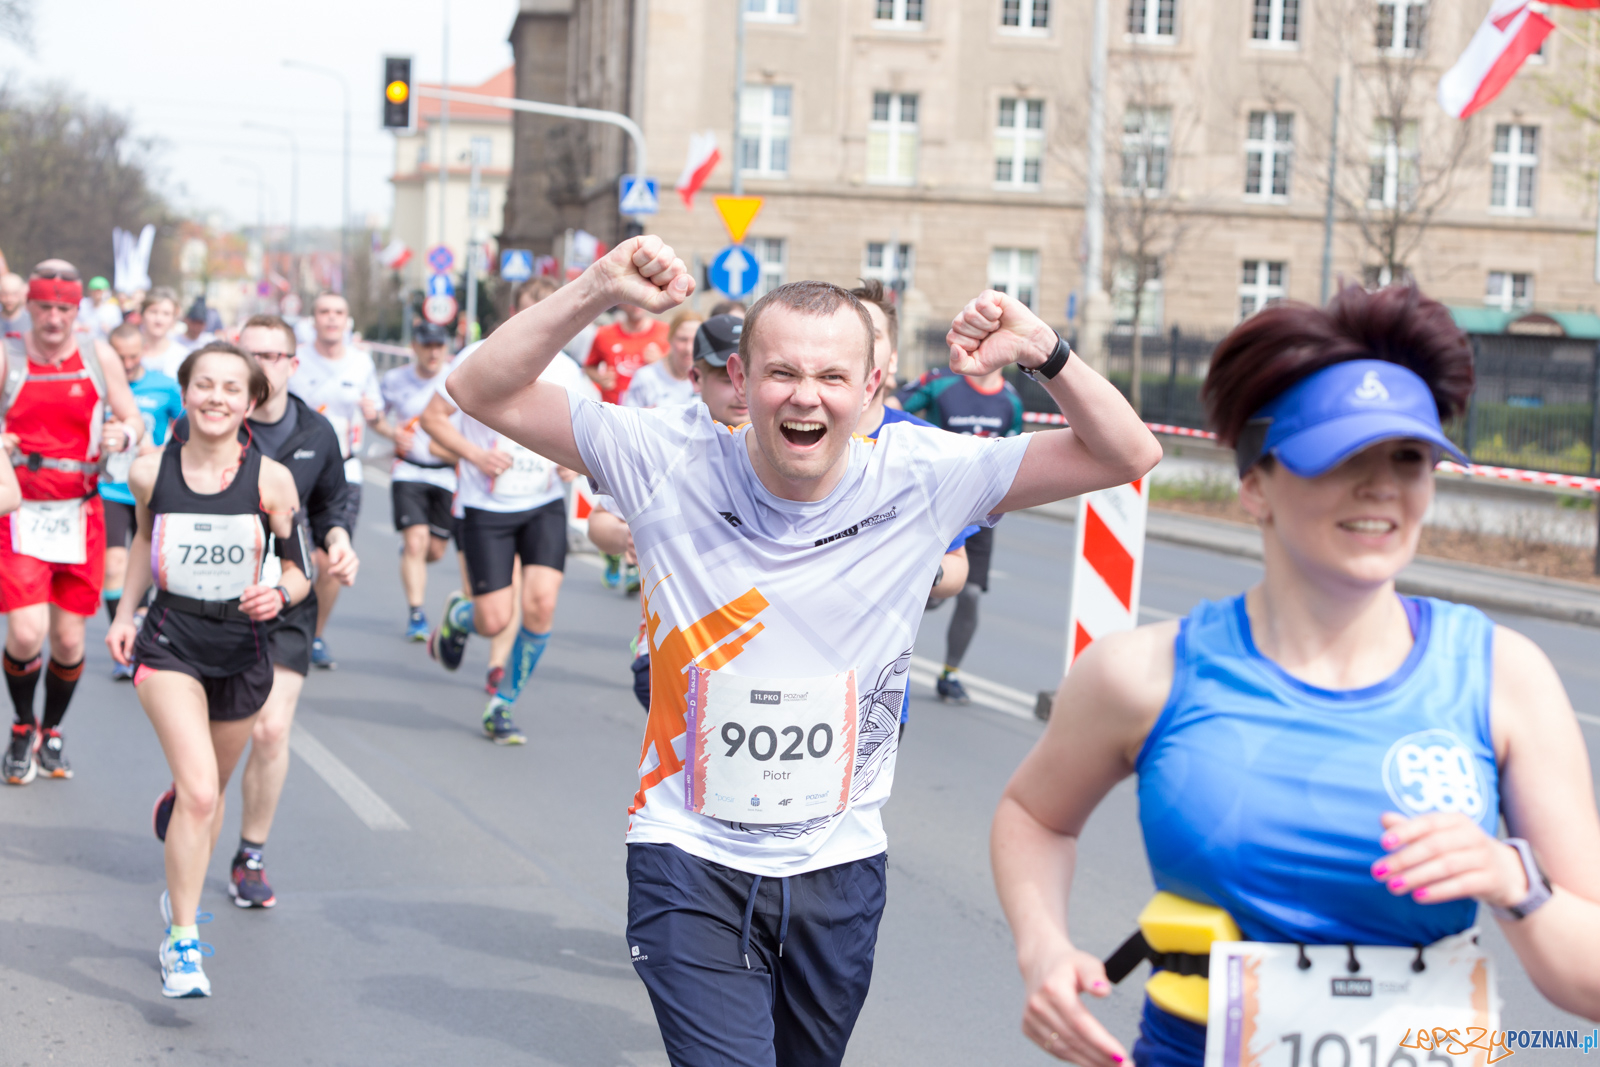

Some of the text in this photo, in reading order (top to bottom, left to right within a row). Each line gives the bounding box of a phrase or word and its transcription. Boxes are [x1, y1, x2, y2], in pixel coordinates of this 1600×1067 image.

[178, 544, 245, 565] 7280
[721, 722, 834, 761] 9020
[763, 770, 792, 780] Piotr
